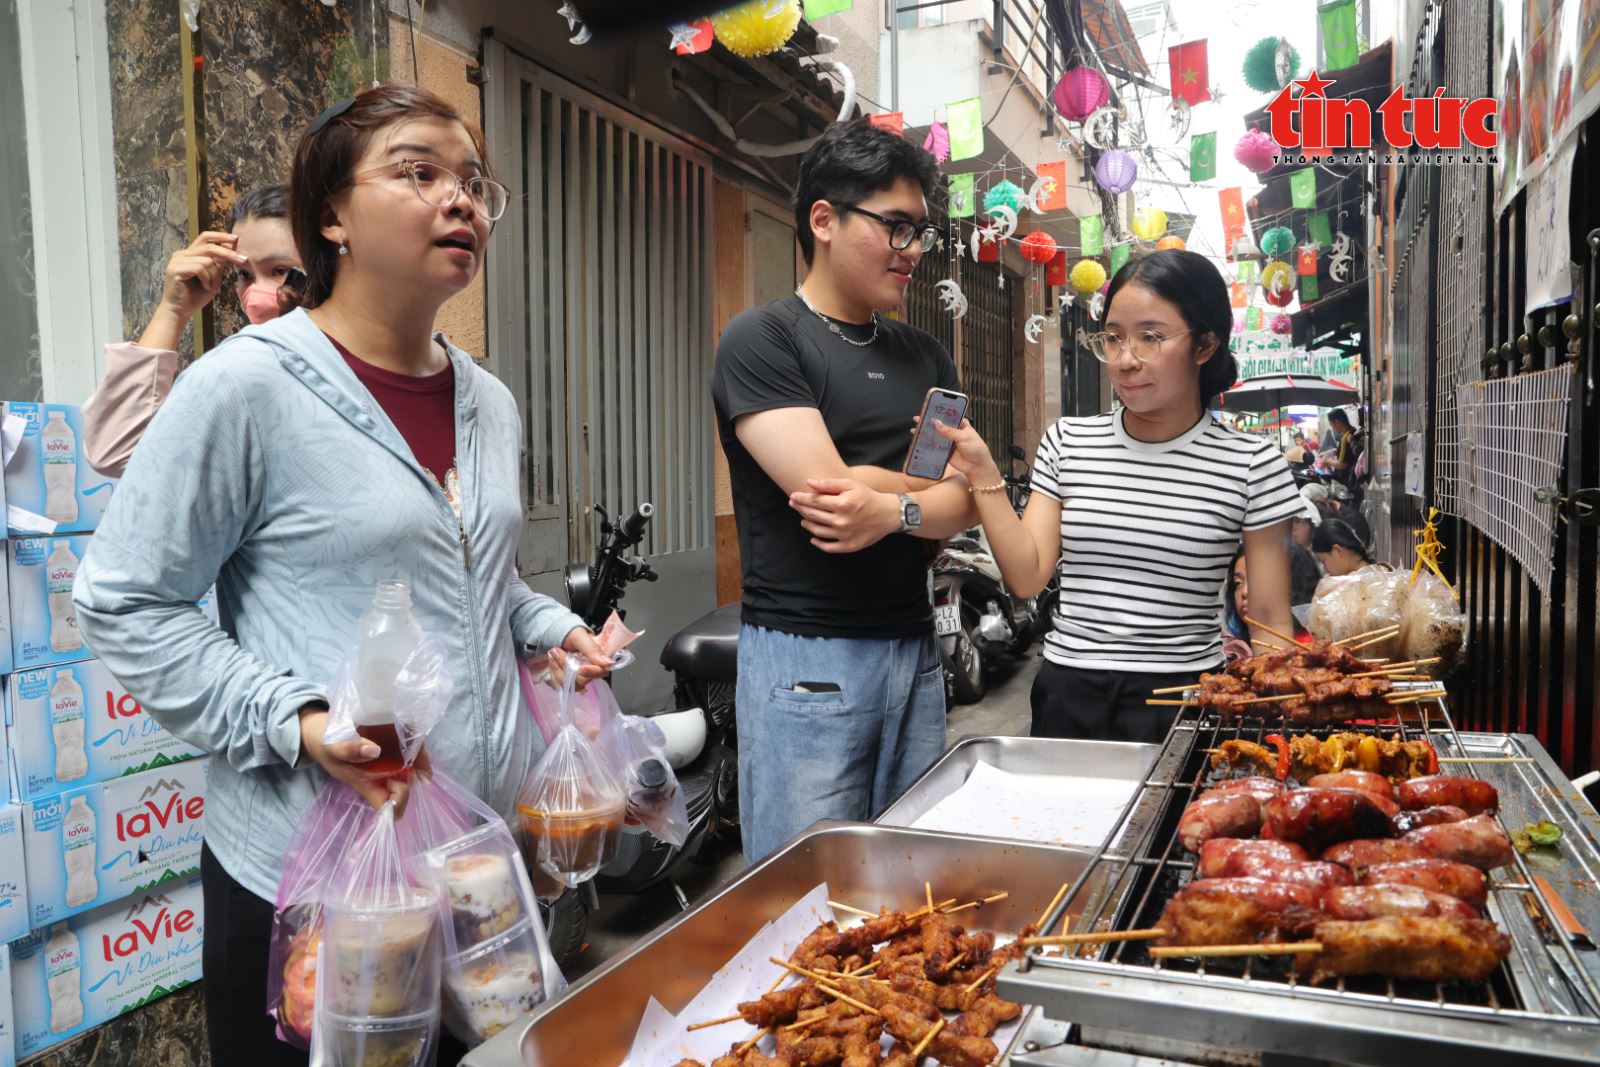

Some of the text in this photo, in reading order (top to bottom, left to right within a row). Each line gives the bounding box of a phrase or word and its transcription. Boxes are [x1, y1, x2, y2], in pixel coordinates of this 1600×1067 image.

[937, 619, 957, 633] 0.31
[116, 792, 205, 842] laVie
[102, 907, 195, 962] laVie
